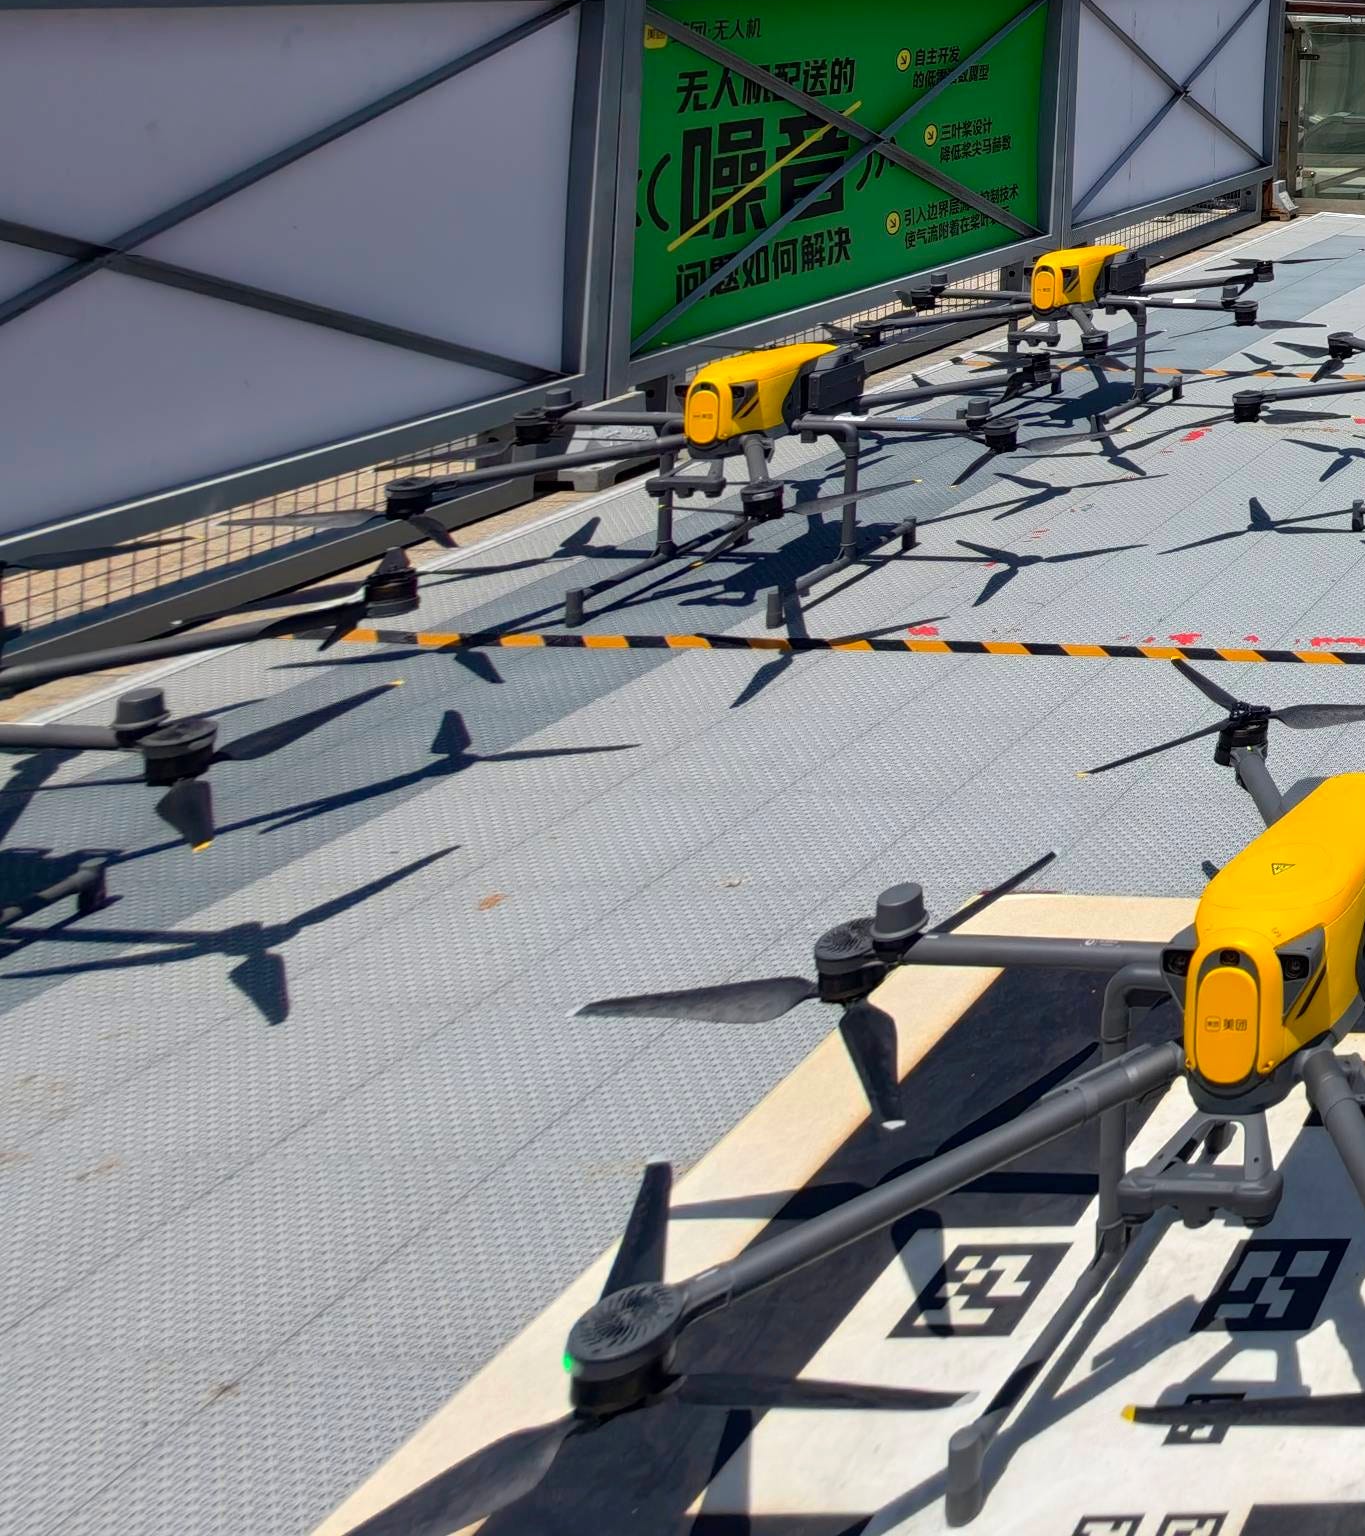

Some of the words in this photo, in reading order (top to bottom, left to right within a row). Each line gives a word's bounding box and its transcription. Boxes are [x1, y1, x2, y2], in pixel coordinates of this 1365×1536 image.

[915, 46, 960, 67] 自主开发
[940, 118, 993, 141] 三叶桨设计
[679, 112, 850, 241] 噪音
[1222, 1018, 1248, 1032] 美团
